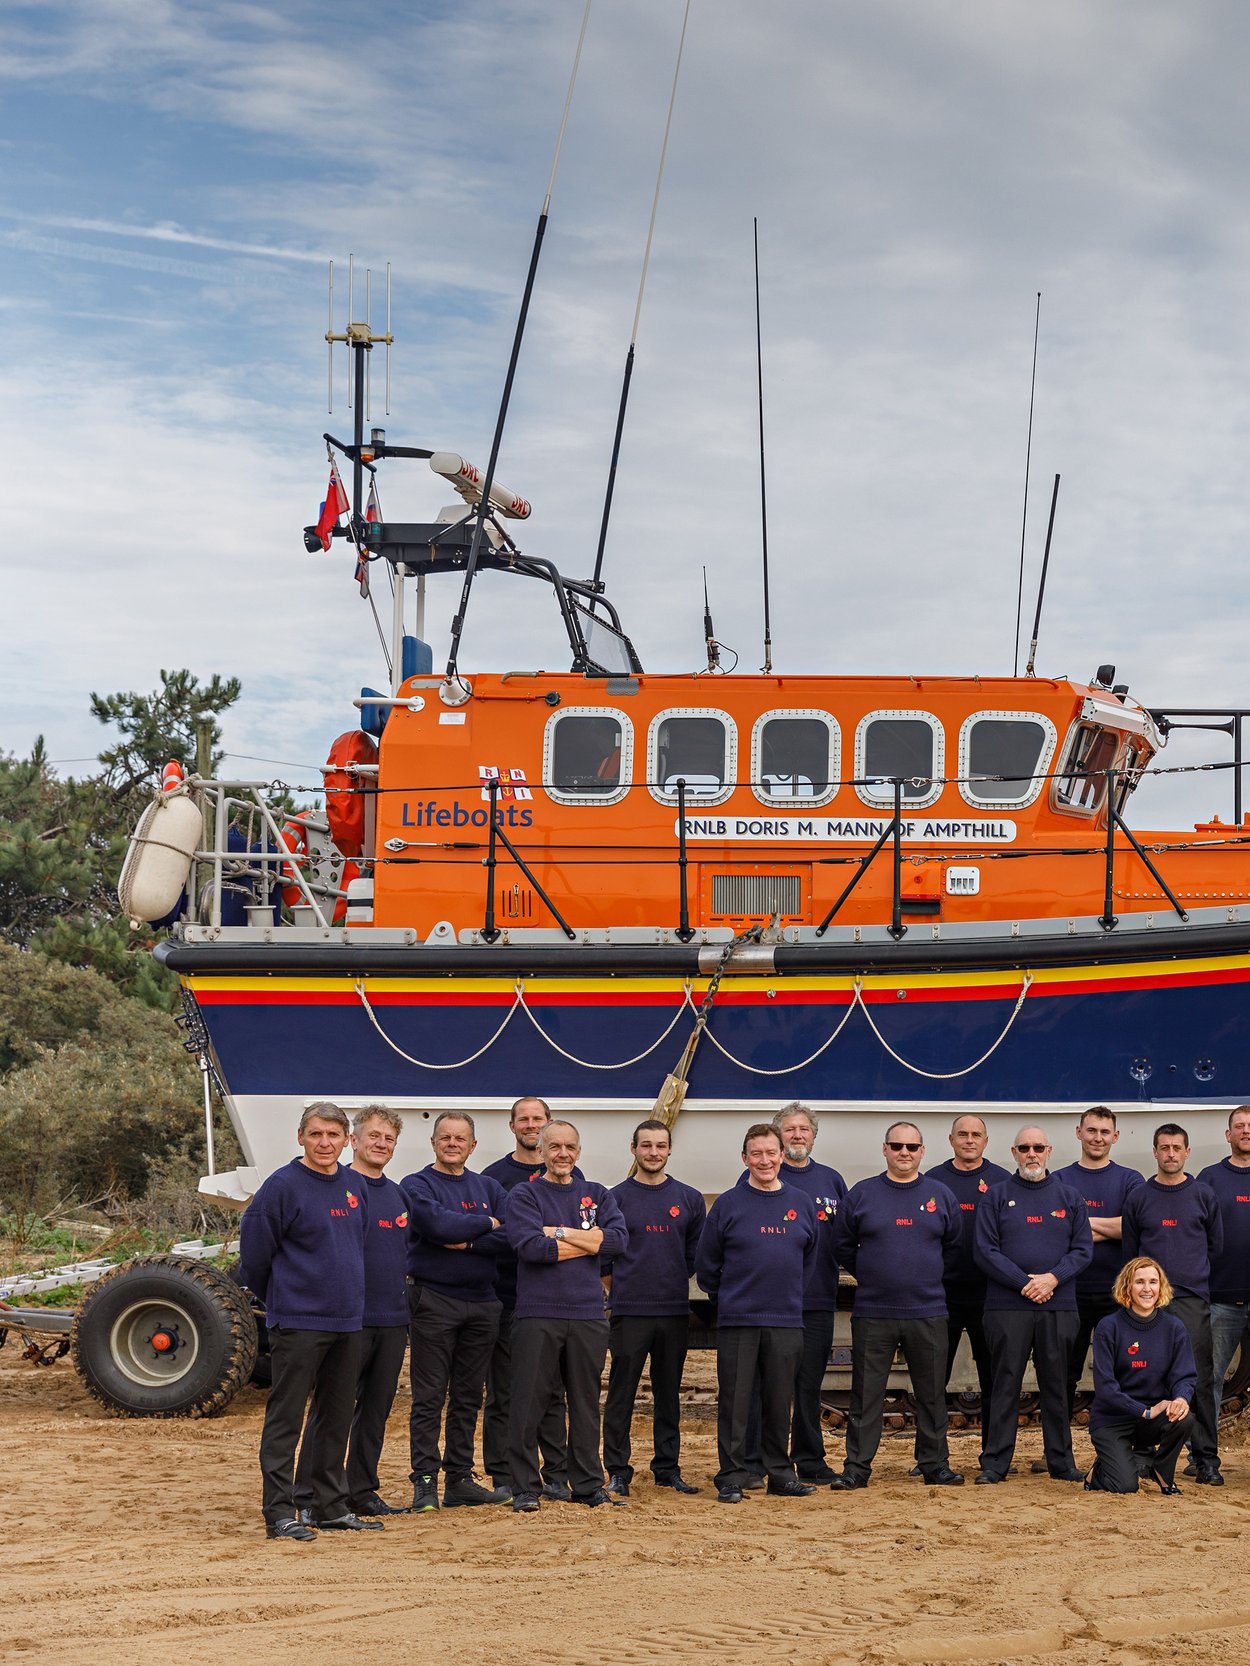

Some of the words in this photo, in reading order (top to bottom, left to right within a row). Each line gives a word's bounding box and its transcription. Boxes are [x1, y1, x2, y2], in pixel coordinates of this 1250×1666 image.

[461, 463, 480, 483] JRC
[511, 495, 529, 516] JRC
[402, 801, 533, 827] Lifeboats
[683, 820, 727, 835] RNLB
[735, 821, 789, 836] DORIS
[797, 822, 818, 836] M.
[827, 822, 883, 837] MANN
[923, 823, 1008, 839] AMPTHILL
[959, 1202, 976, 1211] RNLI
[1087, 1199, 1105, 1208] RNLI
[329, 1208, 350, 1217] RNLI
[378, 1219, 393, 1229] RNLI
[895, 1217, 914, 1227] RNLI
[1026, 1215, 1043, 1224] RNLI
[1161, 1218, 1178, 1227] RNLI
[645, 1224, 669, 1233] RNLI
[759, 1225, 787, 1235] RNLI
[1130, 1360, 1148, 1369] RNLI
